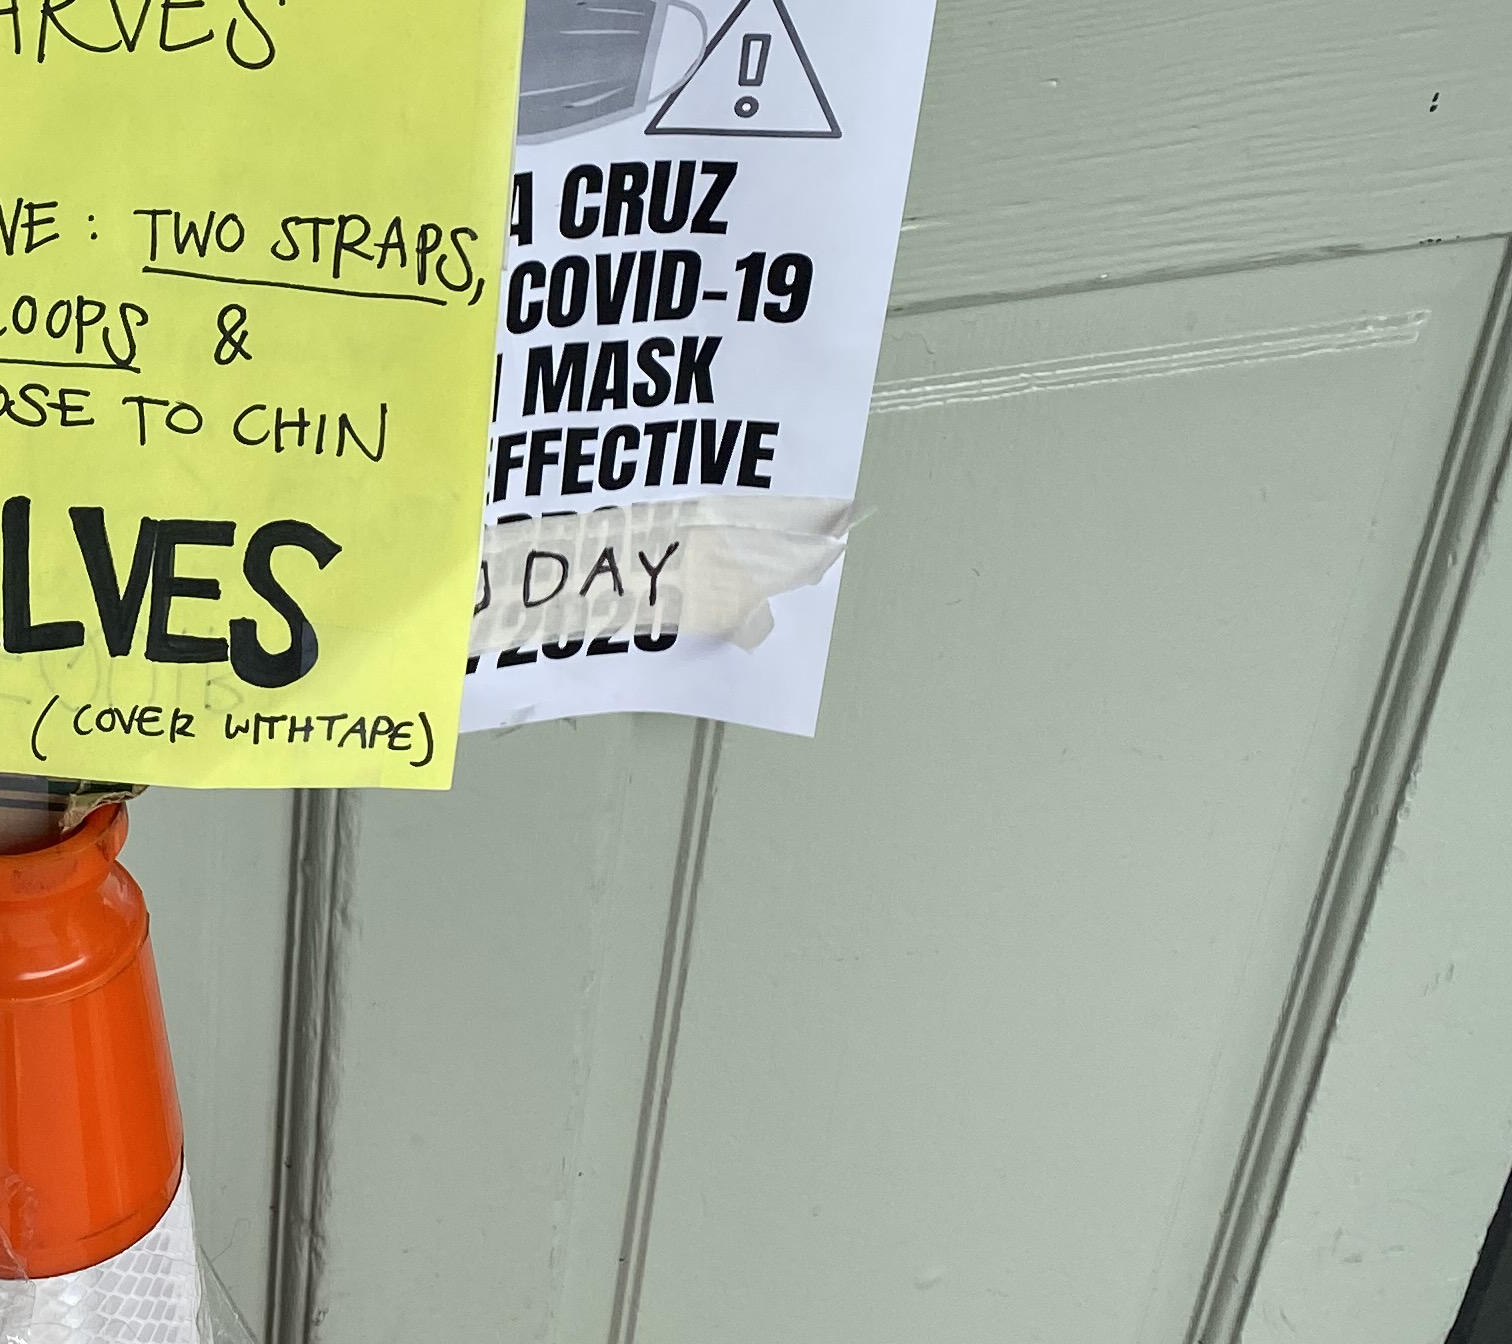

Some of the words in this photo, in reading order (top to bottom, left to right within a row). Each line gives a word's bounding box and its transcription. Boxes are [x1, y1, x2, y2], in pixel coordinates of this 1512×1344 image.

[560, 160, 738, 239] CRUZ
[133, 209, 244, 261] TWO
[271, 214, 485, 305] STRAPS,
[507, 250, 813, 334] COVID-19
[214, 304, 252, 365] &
[522, 336, 722, 416] MASK
[122, 396, 202, 446] TO
[233, 403, 387, 462] CHIN
[487, 419, 781, 506] FFECTIVE
[523, 541, 680, 609] DAY
